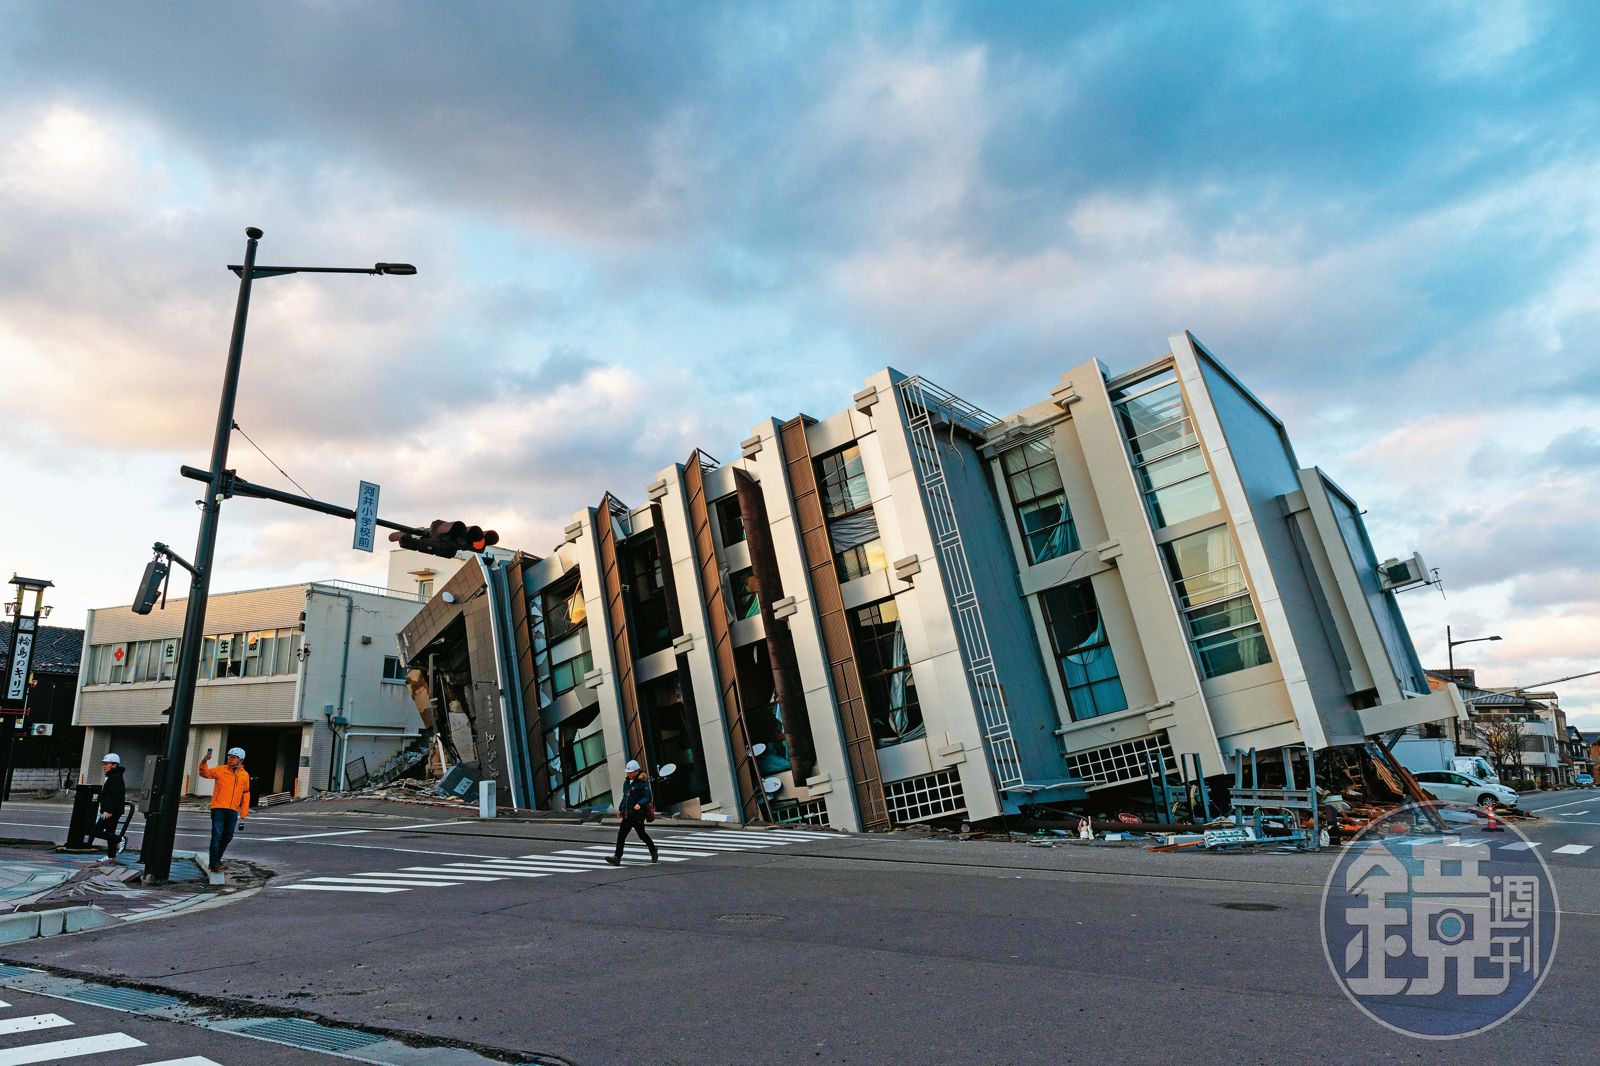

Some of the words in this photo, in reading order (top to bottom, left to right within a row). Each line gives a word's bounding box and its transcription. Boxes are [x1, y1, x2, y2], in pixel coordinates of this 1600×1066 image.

[358, 486, 376, 548] 河井小学校前
[12, 635, 31, 697] 輪島のキリコ
